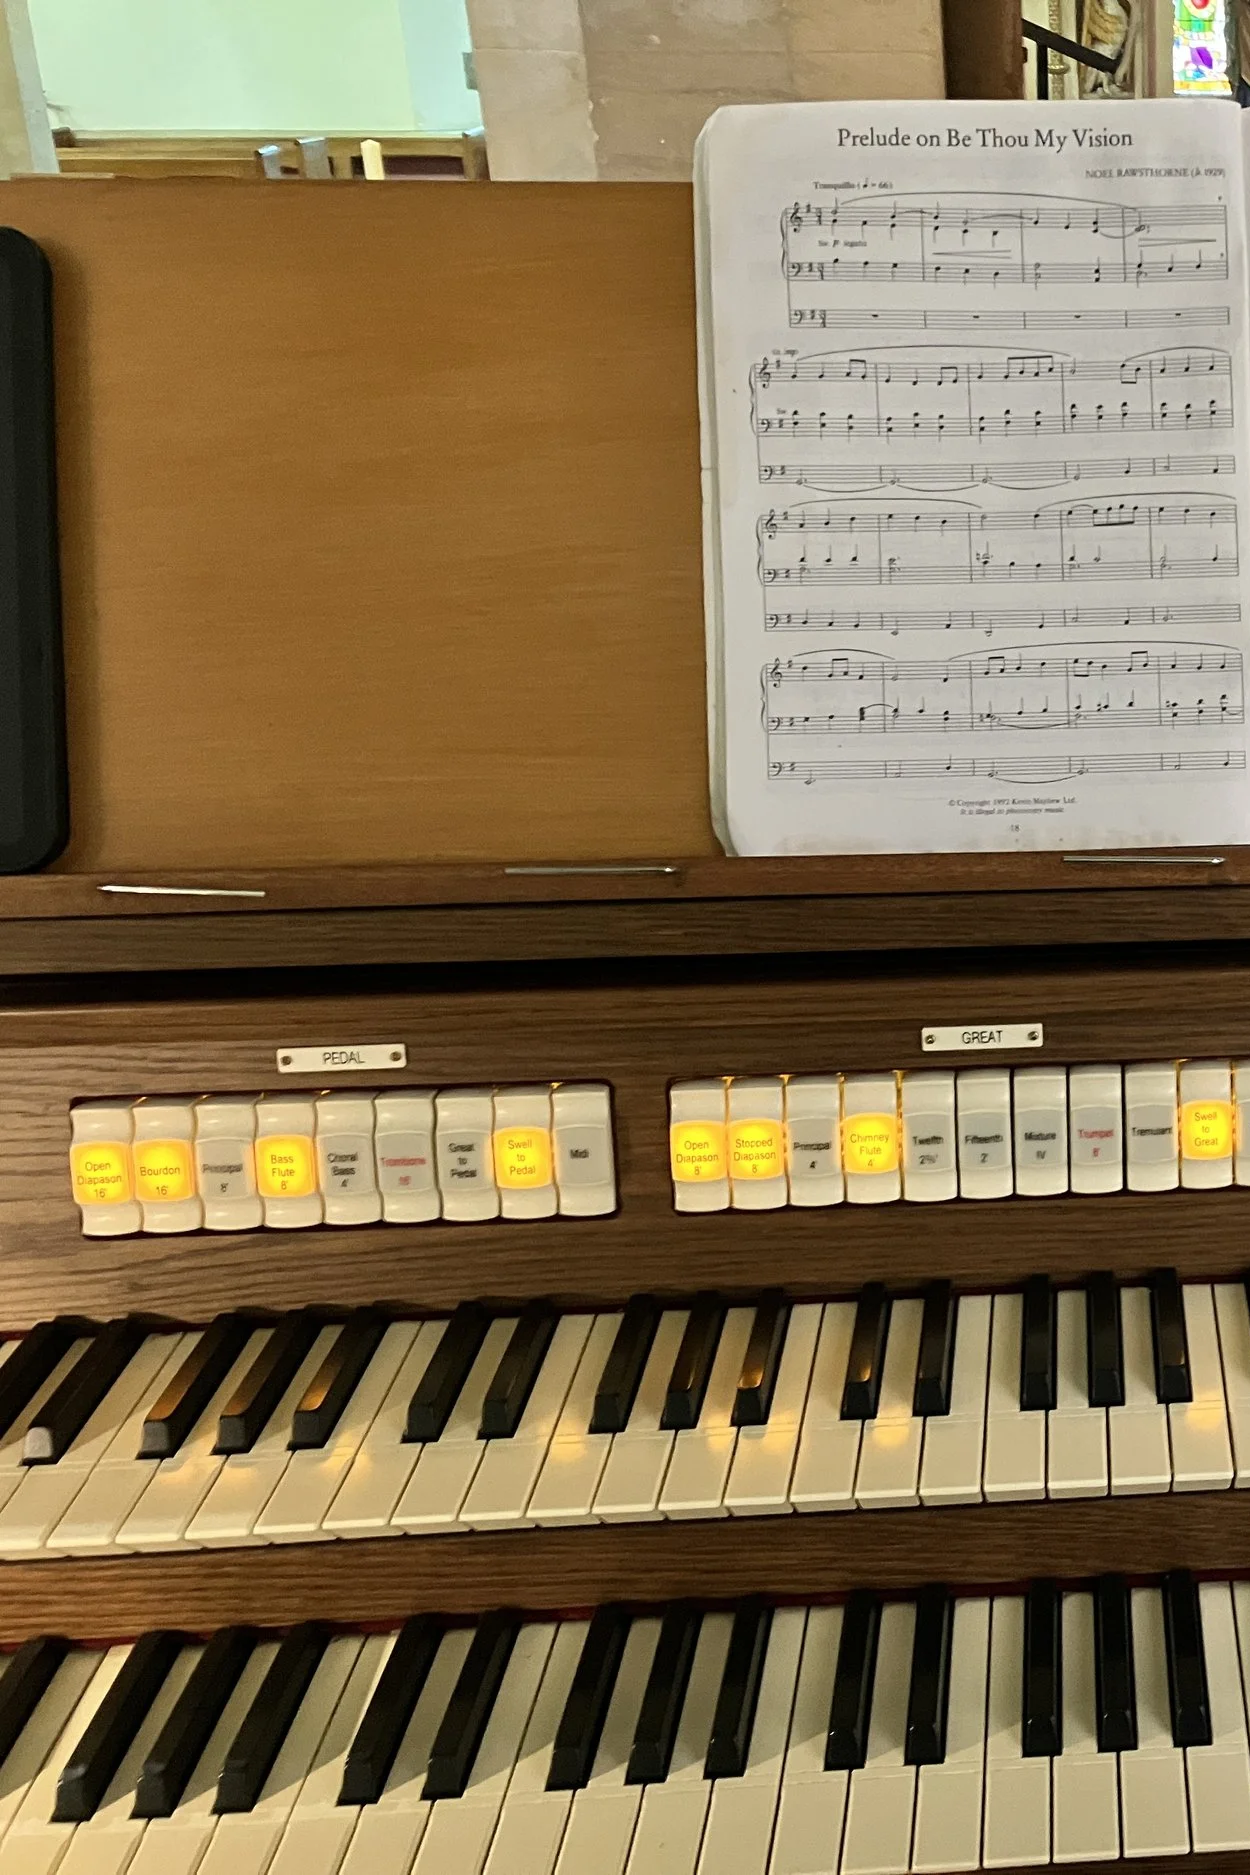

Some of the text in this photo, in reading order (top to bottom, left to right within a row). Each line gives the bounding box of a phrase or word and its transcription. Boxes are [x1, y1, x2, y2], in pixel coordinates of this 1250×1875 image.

[837, 128, 1134, 153] Prelude on Be Thou My Vision
[1085, 168, 1113, 179] NOEL
[962, 1029, 1003, 1044] GREAT
[323, 1050, 366, 1065] PEDAL
[1194, 1110, 1217, 1122] Swell
[1201, 1124, 1211, 1134] to
[508, 1139, 533, 1150] Swell
[735, 1137, 773, 1150] Stopped
[850, 1132, 890, 1146] Chimney
[1194, 1136, 1218, 1148] Great
[449, 1142, 475, 1153] Great
[684, 1139, 709, 1153] Open
[859, 1145, 882, 1156] Flute
[270, 1154, 294, 1165] Bass
[458, 1156, 467, 1166] to
[516, 1153, 526, 1163] to
[676, 1152, 719, 1164] Diapason
[733, 1150, 777, 1162] Diapason
[85, 1161, 111, 1174] Open
[140, 1165, 181, 1177] Bourdon
[272, 1167, 295, 1178] Flute
[509, 1164, 536, 1175] Pedal
[77, 1173, 122, 1186] Diapason
